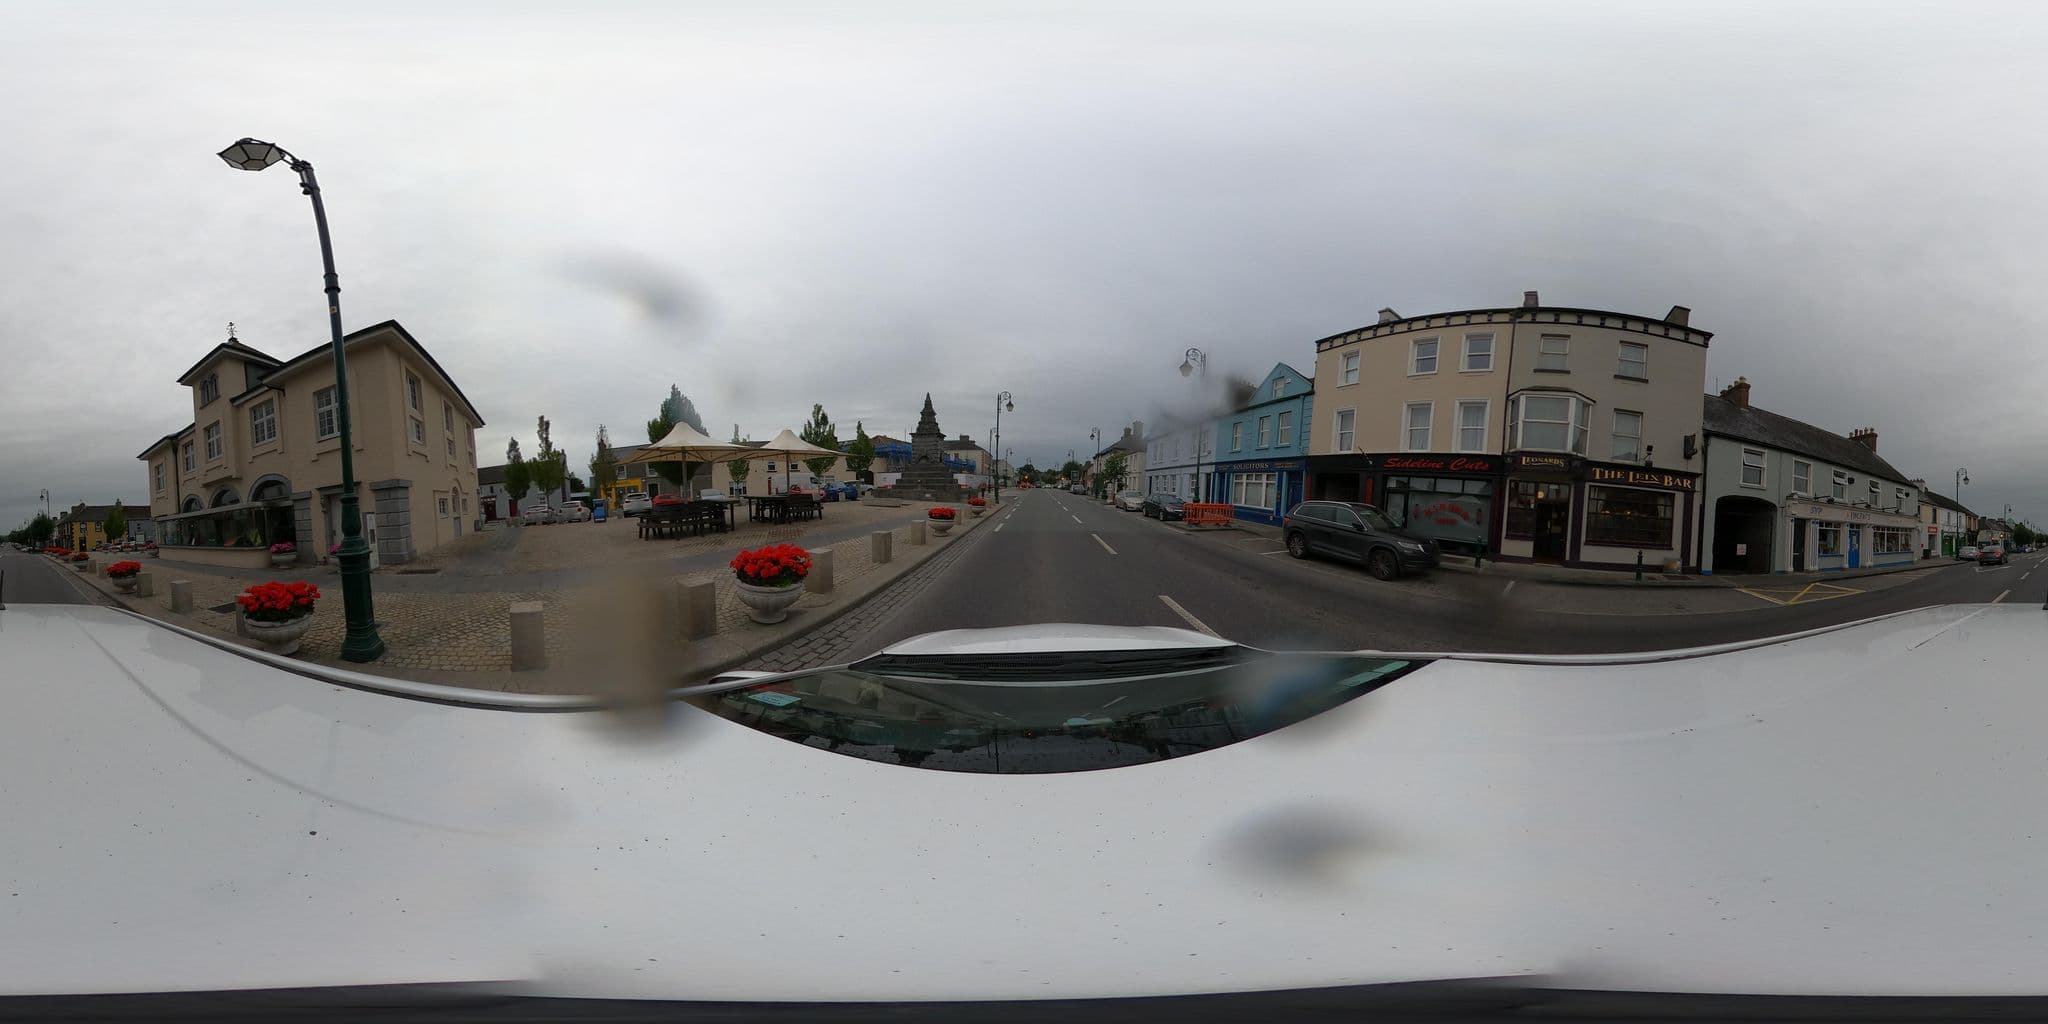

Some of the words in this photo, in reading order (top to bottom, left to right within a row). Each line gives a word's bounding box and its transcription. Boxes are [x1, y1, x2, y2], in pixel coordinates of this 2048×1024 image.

[1448, 456, 1489, 471] Cuts
[1592, 467, 1625, 480] THE
[1662, 475, 1692, 489] BAR
